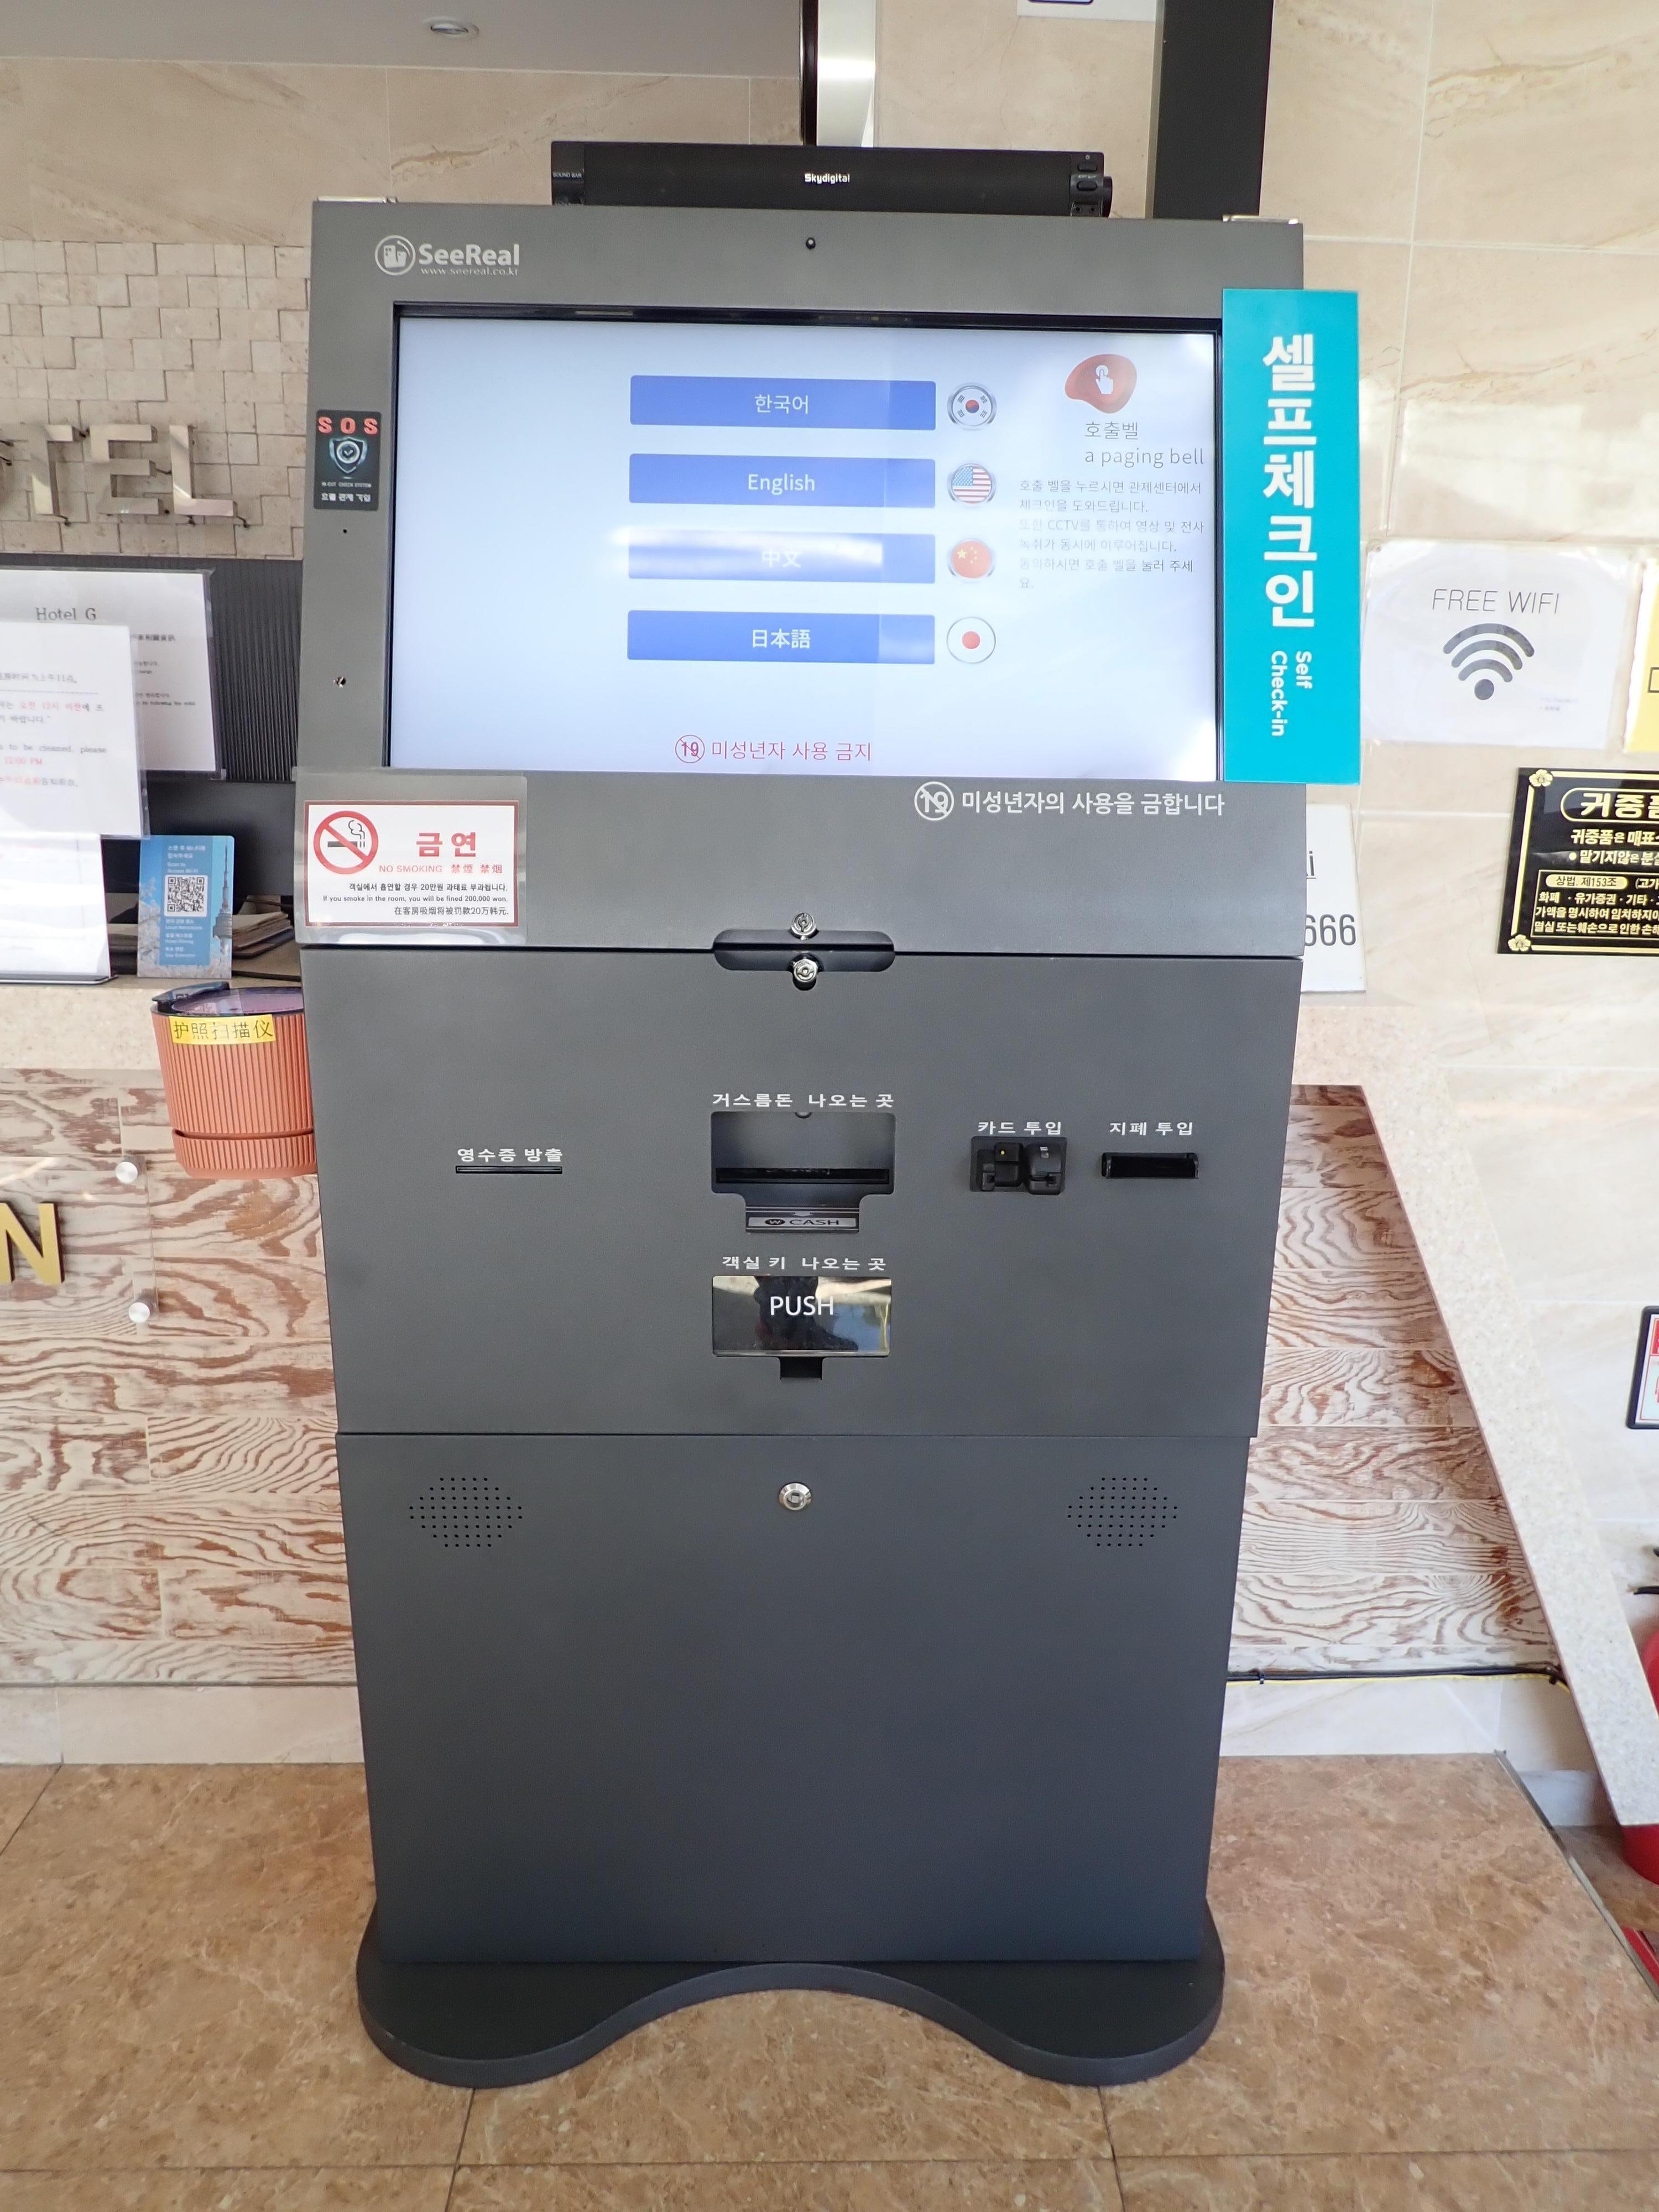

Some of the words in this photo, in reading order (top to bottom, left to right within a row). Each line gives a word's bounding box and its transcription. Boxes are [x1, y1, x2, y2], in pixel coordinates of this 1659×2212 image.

[805, 173, 850, 184] Skydigital
[419, 243, 520, 266] SeeReal
[420, 267, 519, 276] www.seereal.co.kr
[754, 394, 810, 415] 한국어
[1084, 421, 1139, 440] 호출벨
[1085, 451, 1094, 462] a
[1102, 448, 1164, 468] paging
[1170, 448, 1204, 465] bell
[748, 473, 815, 495] English
[1019, 479, 1043, 492] 호출
[1048, 479, 1071, 493] 벨을
[1076, 480, 1124, 494] 누르시면
[1129, 481, 1202, 495] 관제센터에서
[1262, 333, 1317, 628] 셀프체크인
[1019, 499, 1067, 512] 체크인을
[1073, 499, 1149, 513] 도와드립니다.
[1047, 519, 1090, 532] CCTV를
[1097, 519, 1131, 533] 통하여
[1136, 520, 1160, 533] 영상
[1164, 520, 1175, 534] 및
[1181, 520, 1204, 534] 전사
[1060, 538, 1095, 552] 동시에
[1100, 539, 1177, 552] 이루어집니다.
[761, 547, 802, 568] 中文
[1085, 558, 1108, 571] 호출
[1113, 558, 1137, 572] 벨을
[1142, 559, 1164, 572] 눌러
[1169, 559, 1193, 573] 주세
[1432, 588, 1498, 612] FREE
[1508, 591, 1560, 614] WIFI
[35, 607, 77, 622] Hotel
[85, 608, 97, 622] G
[752, 628, 811, 649] 日本語
[1295, 650, 1313, 690] Self
[1271, 650, 1288, 737] Check-in
[712, 741, 785, 761] 미성년자
[792, 742, 828, 761] 사용
[835, 742, 872, 762] 금지
[962, 791, 1065, 814] 미성년자의
[1072, 791, 1135, 815] 사용을
[1141, 792, 1225, 816] 금합니다
[1571, 829, 1625, 845] 귀중품은
[379, 864, 394, 874] NO
[397, 864, 443, 873] SMOKING
[349, 883, 378, 891] 객실에서
[404, 883, 418, 891] 경우
[420, 883, 444, 891] 20만원
[446, 883, 467, 891] 과태료
[1581, 876, 1617, 888] 제153조
[1305, 914, 1357, 947] 666
[173, 1019, 273, 1040] 护照扫描仪
[712, 1093, 793, 1108] 거스름돈
[808, 1093, 868, 1108] 나오는
[875, 1093, 894, 1108] 곳
[977, 1121, 1016, 1135] 카드
[1024, 1121, 1062, 1135] 투입
[1109, 1122, 1147, 1135] 지폐
[1155, 1122, 1193, 1136] 투입
[457, 1148, 517, 1162] 영수증
[524, 1148, 563, 1162] 방출
[722, 1256, 760, 1270] 객실
[769, 1257, 786, 1270] 키
[802, 1257, 860, 1270] 나오는
[868, 1258, 886, 1271] 곳
[770, 1296, 834, 1316] PUSH
